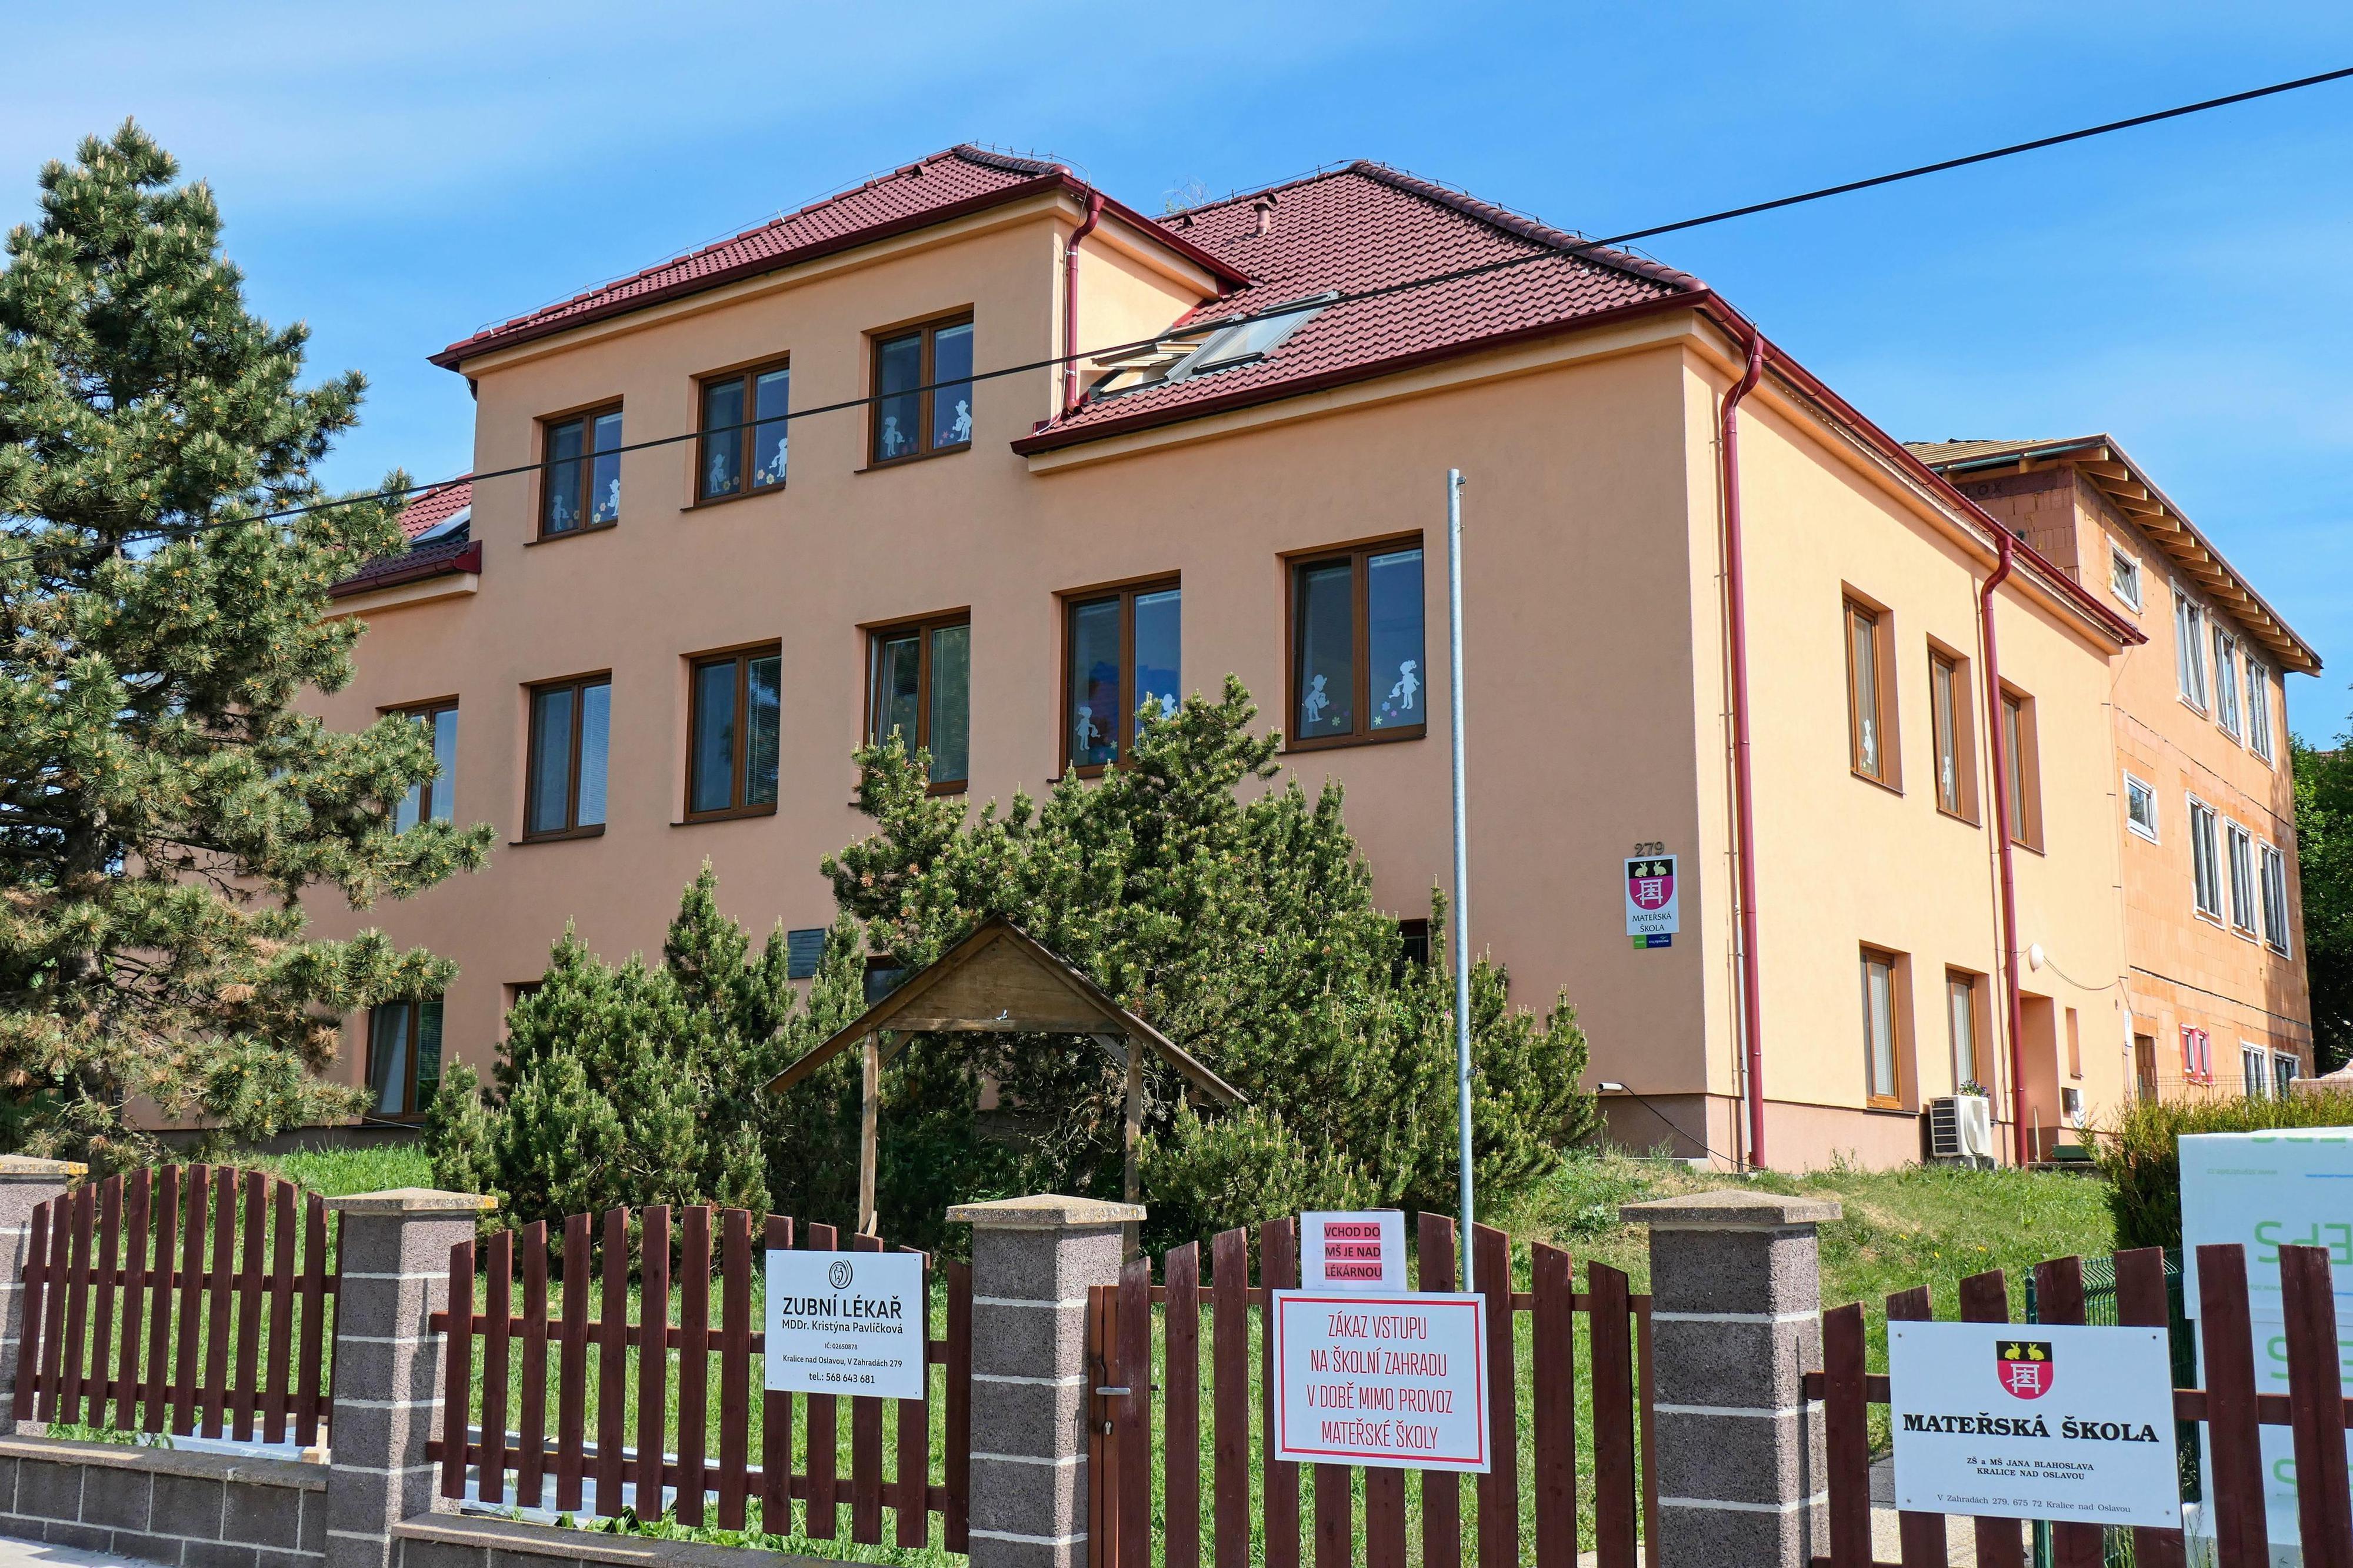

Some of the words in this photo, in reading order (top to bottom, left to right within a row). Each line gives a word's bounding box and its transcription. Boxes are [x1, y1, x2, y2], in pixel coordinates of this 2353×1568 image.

[1634, 841, 1665, 857] 279
[1632, 911, 1672, 922] MATEŘSKÁ
[1324, 1227, 1361, 1237] VCHOD
[1364, 1227, 1381, 1237] DO
[1325, 1244, 1341, 1257] MŠ
[1344, 1247, 1354, 1257] JE
[1357, 1247, 1381, 1257] NAD
[1325, 1264, 1382, 1277] LÉKÁRNOU
[783, 1294, 838, 1316] ZUBNÍ
[843, 1295, 902, 1319] LÉKAŘ
[782, 1319, 809, 1330] MDDr.
[812, 1320, 850, 1334] Kristýna
[853, 1322, 904, 1334] Pavlíčková
[1328, 1310, 1368, 1337] ZÁKAZ
[1372, 1316, 1427, 1339] VSTUPU
[805, 1355, 817, 1363] nad
[818, 1356, 846, 1366] Oslavou,
[853, 1358, 888, 1367] Zahradách
[1311, 1350, 1328, 1372] NA
[1333, 1345, 1381, 1374] ŠKOLNÍ
[1384, 1352, 1447, 1376] ZAHRADU
[809, 1372, 824, 1381] tel.:
[826, 1373, 841, 1382] 568
[842, 1374, 858, 1383] 643
[860, 1374, 875, 1383] 681
[1307, 1384, 1315, 1407] V
[1320, 1382, 1354, 1409] DOBĚ
[1359, 1387, 1394, 1410] MIMO
[1399, 1389, 1453, 1413] PROVOZ
[1322, 1417, 1391, 1447] MATEŘSKÉ
[1396, 1420, 1438, 1449] ŠKOLY
[1902, 1412, 2051, 1438] MATEŘSKÁ
[2062, 1416, 2159, 1443] ŠKOLA
[1989, 1457, 2003, 1466] MŠ
[2034, 1461, 2094, 1471] BLAHOSLAVA
[1977, 1467, 2016, 1476] KRALICE
[2042, 1471, 2085, 1480] OSLAVOU
[1947, 1495, 1989, 1504] Zahradách
[2012, 1499, 2028, 1507] 675
[2046, 1500, 2075, 1510] Kralice
[2098, 1504, 2131, 1513] Oslavou
